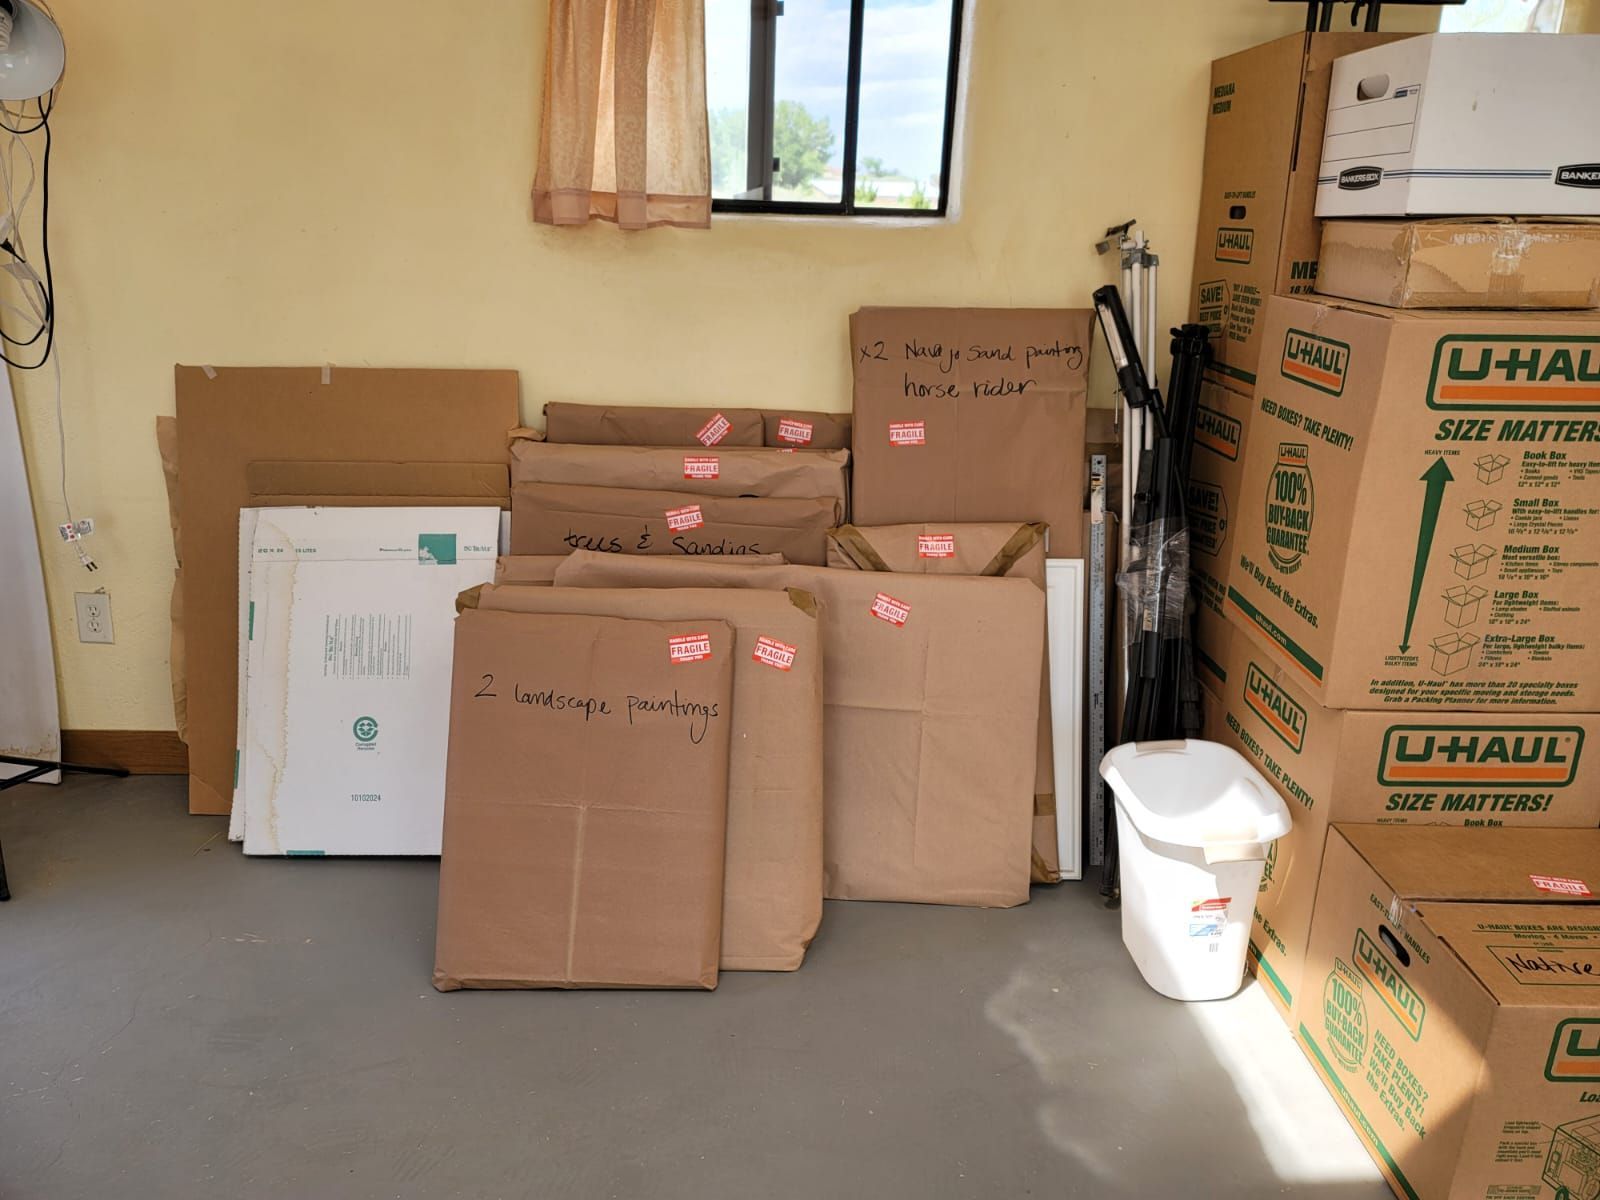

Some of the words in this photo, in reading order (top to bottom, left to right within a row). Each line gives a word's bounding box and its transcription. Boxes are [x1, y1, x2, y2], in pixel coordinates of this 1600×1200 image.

[1218, 233, 1251, 250] U-HAUL
[1200, 285, 1224, 304] SAVE!
[1025, 340, 1084, 371] painting
[1287, 336, 1343, 376] U-HAUL
[904, 372, 960, 399] horse
[973, 377, 1037, 399] rider
[702, 419, 728, 447] FRAGILE
[780, 426, 811, 439] FRAGILE
[890, 428, 924, 440] FRAGILE
[1261, 397, 1278, 416] NEED
[1277, 405, 1304, 428] BOXES?
[1303, 416, 1322, 437] TAKE
[1321, 425, 1354, 452] PLENTY!
[1434, 418, 1495, 441] SIZE
[1280, 447, 1306, 458] U-HAUL
[1523, 451, 1547, 460] Book
[1549, 451, 1567, 460] Box
[684, 463, 718, 473] FRAGILE
[1275, 470, 1307, 506] 100%
[1513, 498, 1540, 507] Small
[1542, 499, 1559, 507] Box
[668, 513, 702, 527] FRAGILE
[1268, 503, 1310, 532] BUY-BACK
[919, 543, 953, 551] FRAGILE
[1503, 545, 1541, 554] Medium
[1542, 545, 1560, 554] Box
[1254, 566, 1266, 586] Buy
[1266, 577, 1282, 596] Back
[1282, 590, 1294, 608] the
[1294, 600, 1319, 629] Extras.
[1494, 590, 1520, 600] Large
[1521, 590, 1540, 599] Box
[873, 601, 907, 621] FRAGILE
[1254, 613, 1287, 646] uhaul.com
[1484, 634, 1537, 643] Extra-Large
[1538, 634, 1556, 642] Box
[671, 642, 709, 656] FRAGILE
[755, 645, 793, 664] FRAGILE
[1519, 681, 1554, 689] specialty
[474, 674, 497, 697] 2
[626, 689, 720, 744] paintings
[1250, 669, 1301, 735] U-HAUL
[1411, 696, 1443, 704] Packing
[1226, 711, 1241, 735] NEED
[1240, 728, 1264, 760] BOXES?
[1263, 755, 1282, 779] TAKE
[1281, 773, 1314, 811] PLENTY!
[1395, 735, 1568, 763] U-HAUL
[351, 794, 381, 802] 10102024
[1385, 793, 1438, 811] SIZE
[1440, 794, 1554, 812] MATTERS!
[1463, 819, 1485, 827] Book
[1487, 819, 1504, 828] Box
[1534, 879, 1586, 892] FRAGILE
[1263, 919, 1287, 957] Extras.
[1404, 931, 1431, 965] HANDLES
[1336, 960, 1361, 990] U-HAUL
[1359, 937, 1418, 1023] U-HAUL
[1332, 978, 1362, 1027] 100%
[1326, 1000, 1364, 1050] BUY-BACK
[1374, 1029, 1396, 1060] NEED
[1396, 1057, 1429, 1103] BOXES?
[1372, 1043, 1392, 1073] TAKE
[1391, 1070, 1425, 1117] PLENTY!
[1366, 1071, 1379, 1092] the
[1379, 1091, 1405, 1132] Extras.
[1369, 1057, 1388, 1086] We'll
[1388, 1084, 1404, 1110] Buy
[1405, 1106, 1427, 1140] Back
